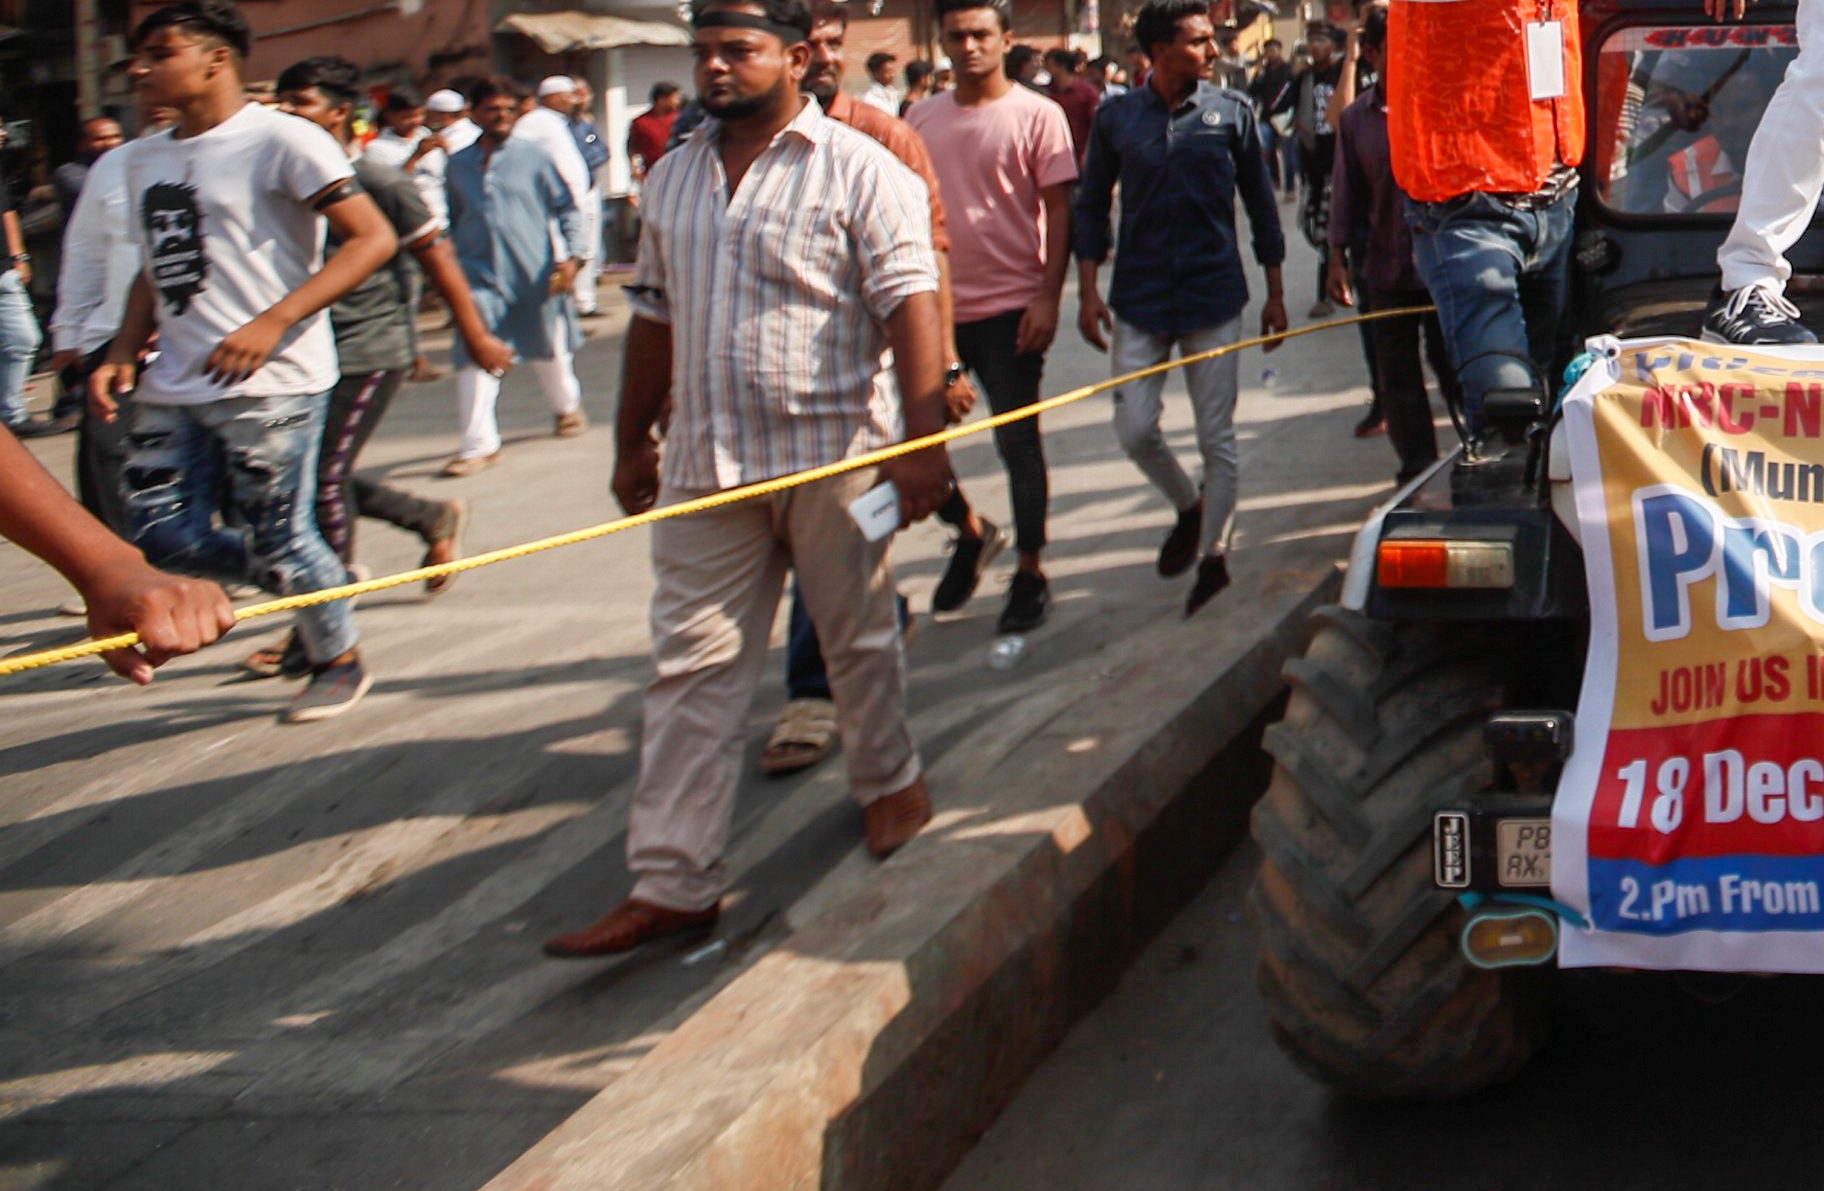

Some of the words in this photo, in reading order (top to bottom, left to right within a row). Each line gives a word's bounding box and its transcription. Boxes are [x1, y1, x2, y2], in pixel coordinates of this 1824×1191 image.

[1651, 661, 1726, 716] JOIN
[1736, 655, 1792, 703] US
[1617, 756, 1691, 835] 18
[1618, 875, 1710, 922] 2.Pm
[1719, 873, 1821, 915] From
